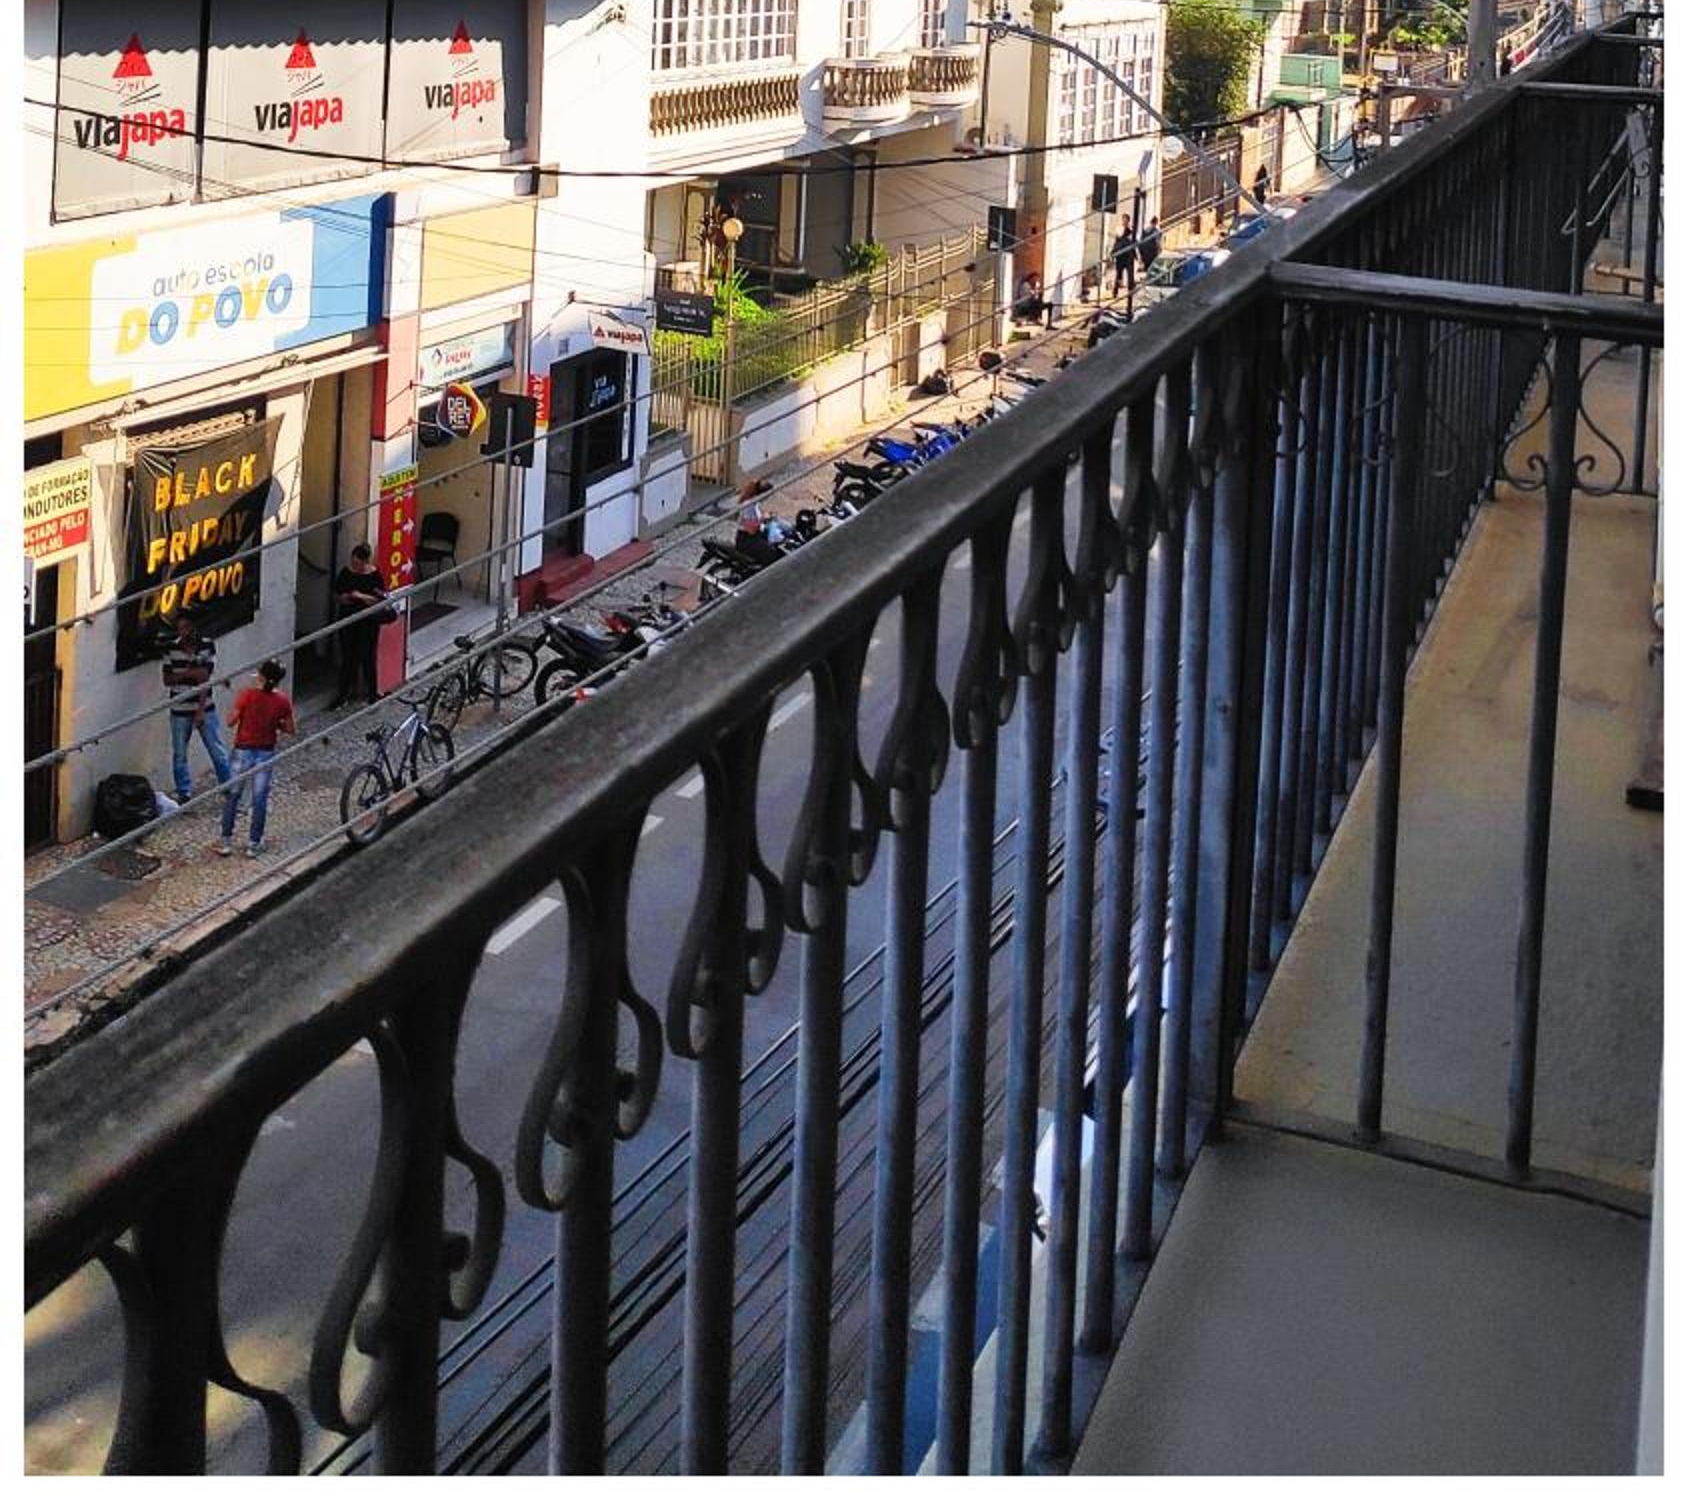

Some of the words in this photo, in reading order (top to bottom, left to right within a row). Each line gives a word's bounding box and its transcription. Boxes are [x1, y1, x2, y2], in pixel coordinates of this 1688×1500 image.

[255, 97, 343, 143] viajapa
[153, 267, 200, 297] auto
[205, 251, 274, 285] escola
[115, 301, 179, 355] DO
[186, 273, 293, 338] POVO
[447, 397, 471, 411] DEL
[448, 408, 471, 425] REY
[155, 453, 257, 512] BLACK
[147, 509, 248, 575] FRIDAY
[182, 561, 244, 609] POVO
